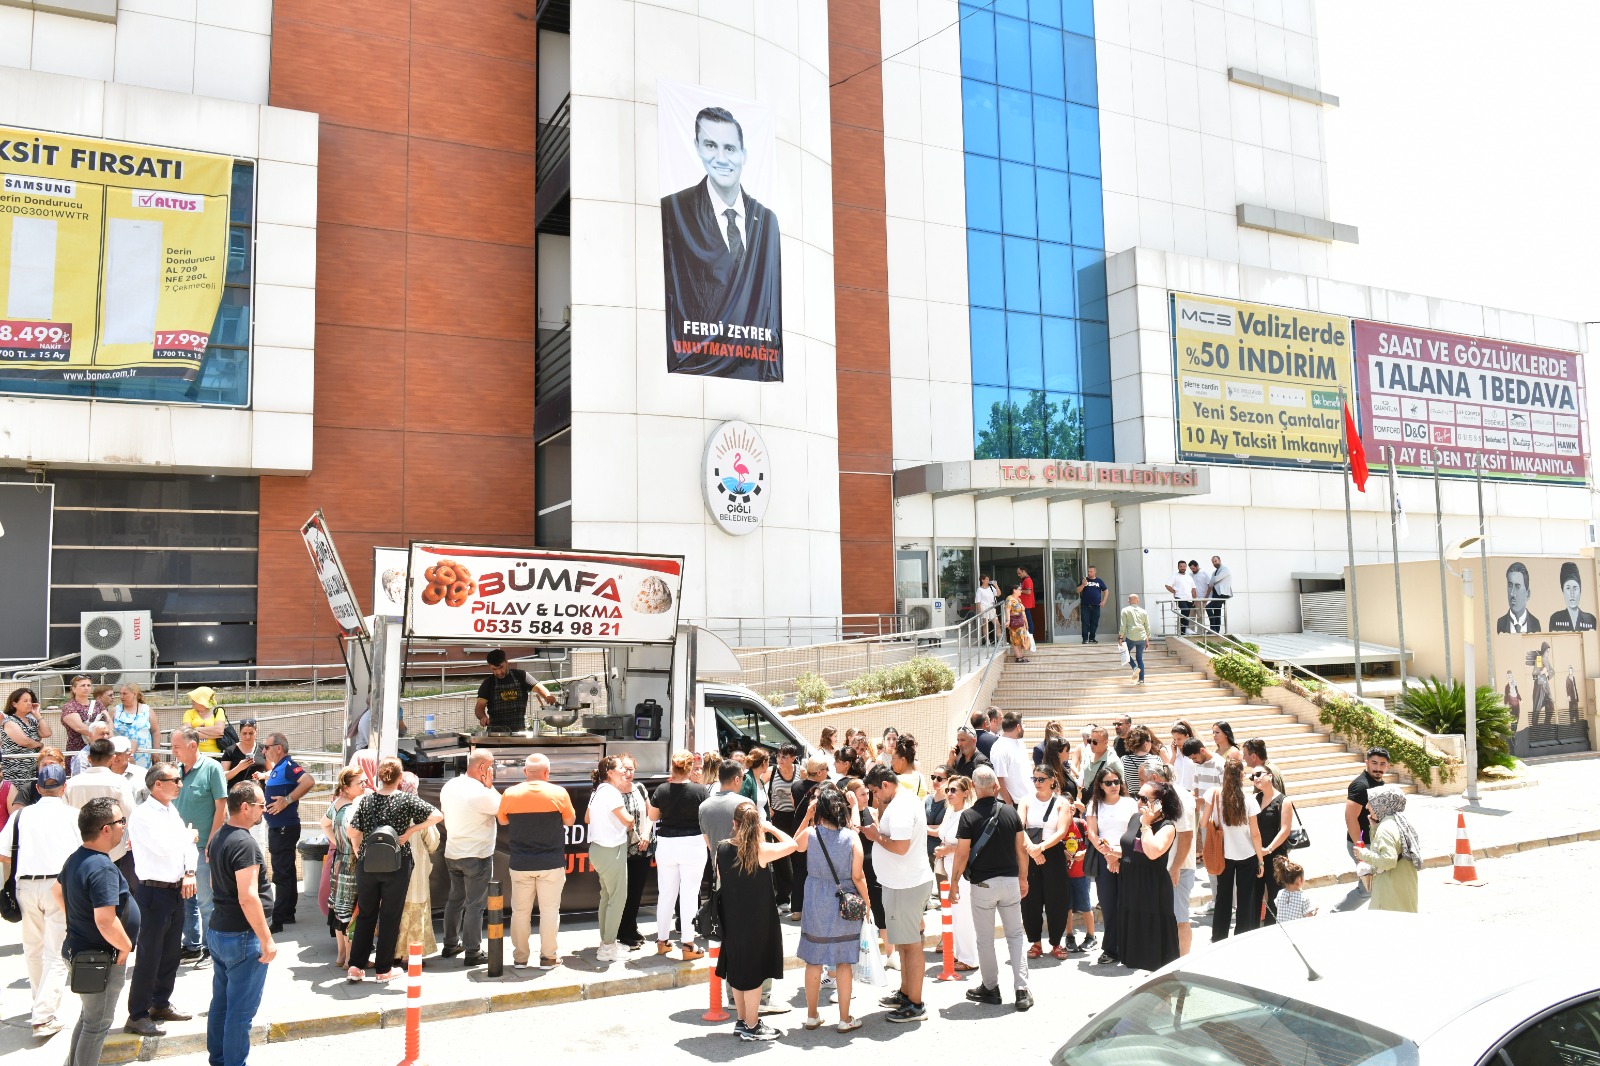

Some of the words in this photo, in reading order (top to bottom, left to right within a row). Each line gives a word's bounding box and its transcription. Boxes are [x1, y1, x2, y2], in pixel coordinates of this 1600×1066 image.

[71, 148, 183, 180] FIRSATI
[5, 178, 71, 194] SAMSUNG
[24, 196, 83, 209] Dondurucu
[155, 197, 197, 211] ALTUS
[166, 247, 192, 256] Derin
[166, 255, 215, 265] Dondurucu
[165, 266, 178, 274] AL
[180, 265, 198, 274] 709
[185, 273, 207, 282] 260L
[172, 282, 216, 293] Çekmeceli
[683, 320, 724, 336] FERDİ
[727, 324, 772, 342] ZEYREK
[1237, 310, 1345, 347] Valizlerde
[17, 350, 28, 358] TL
[53, 351, 65, 360] Ay
[1186, 341, 1230, 370] %50
[1238, 339, 1337, 381] İNDİRİM
[1378, 332, 1423, 358] SAAT
[1427, 342, 1449, 362] VE
[1454, 340, 1568, 378] GÖZLÜKLERDE
[63, 368, 137, 380] www.banco.com.tr
[1193, 401, 1225, 420] Yeni
[1229, 405, 1274, 425] Sezon
[1186, 426, 1205, 443] 10
[1209, 429, 1229, 450] Ay
[1232, 430, 1277, 450] Taksit
[1404, 423, 1427, 439] D&G
[1458, 433, 1482, 442] GUESS
[1557, 440, 1577, 450] HAWK
[1399, 447, 1417, 464] AY
[1510, 452, 1575, 475] İMKANIYLA
[1001, 464, 1036, 480] T.C.
[1043, 461, 1093, 484] ÇİĞLİ
[1098, 466, 1199, 487] BELEDİYESİ
[478, 561, 621, 603] BÜMFA
[536, 603, 548, 617] &
[554, 603, 623, 619] LOKMA
[133, 616, 141, 641] VESTEL
[473, 618, 522, 634] 0535
[528, 620, 564, 635] 584
[570, 621, 593, 636] 98
[598, 622, 620, 636] 21
